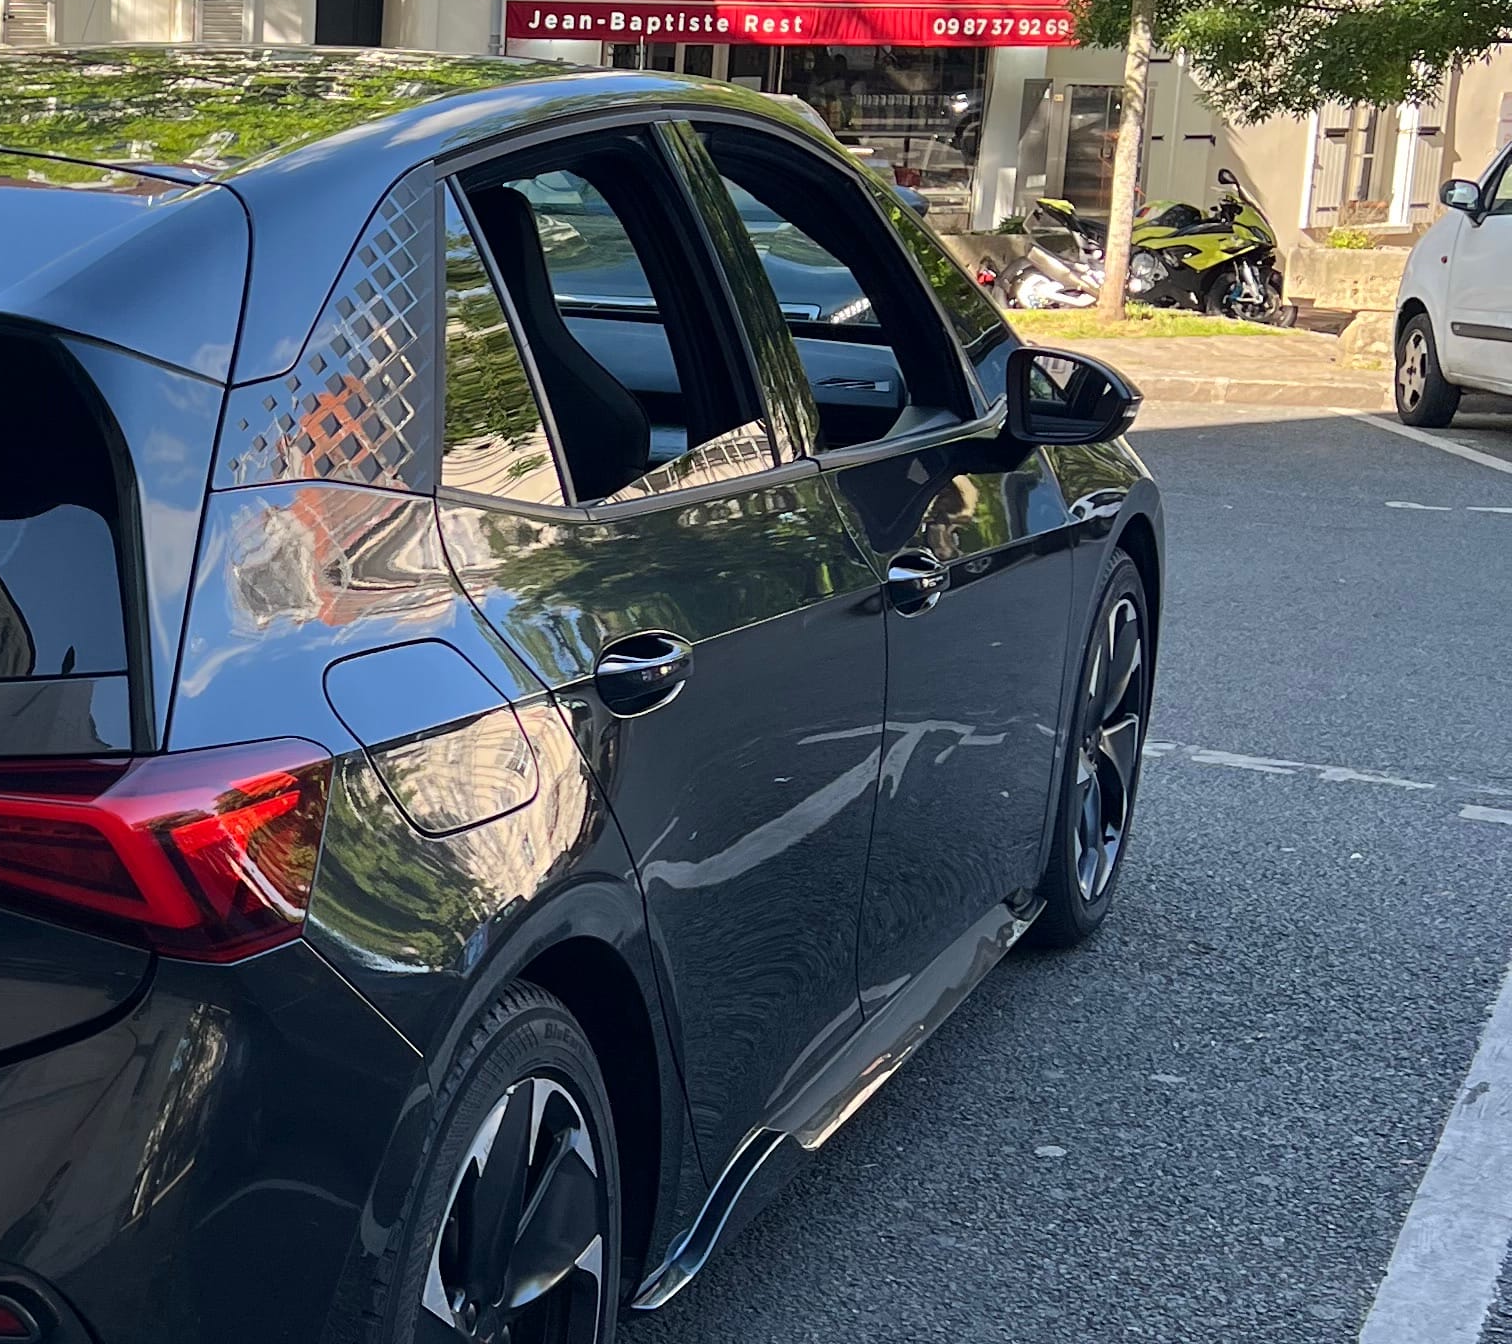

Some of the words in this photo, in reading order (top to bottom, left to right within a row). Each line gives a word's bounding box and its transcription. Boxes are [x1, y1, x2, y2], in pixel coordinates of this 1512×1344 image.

[528, 10, 729, 35] Jean-Baptiste
[744, 14, 803, 33] Rest
[933, 18, 960, 35] 09
[963, 18, 987, 35] 87
[991, 19, 1014, 35] 37
[1018, 19, 1041, 35] 92
[1045, 19, 1069, 35] 69
